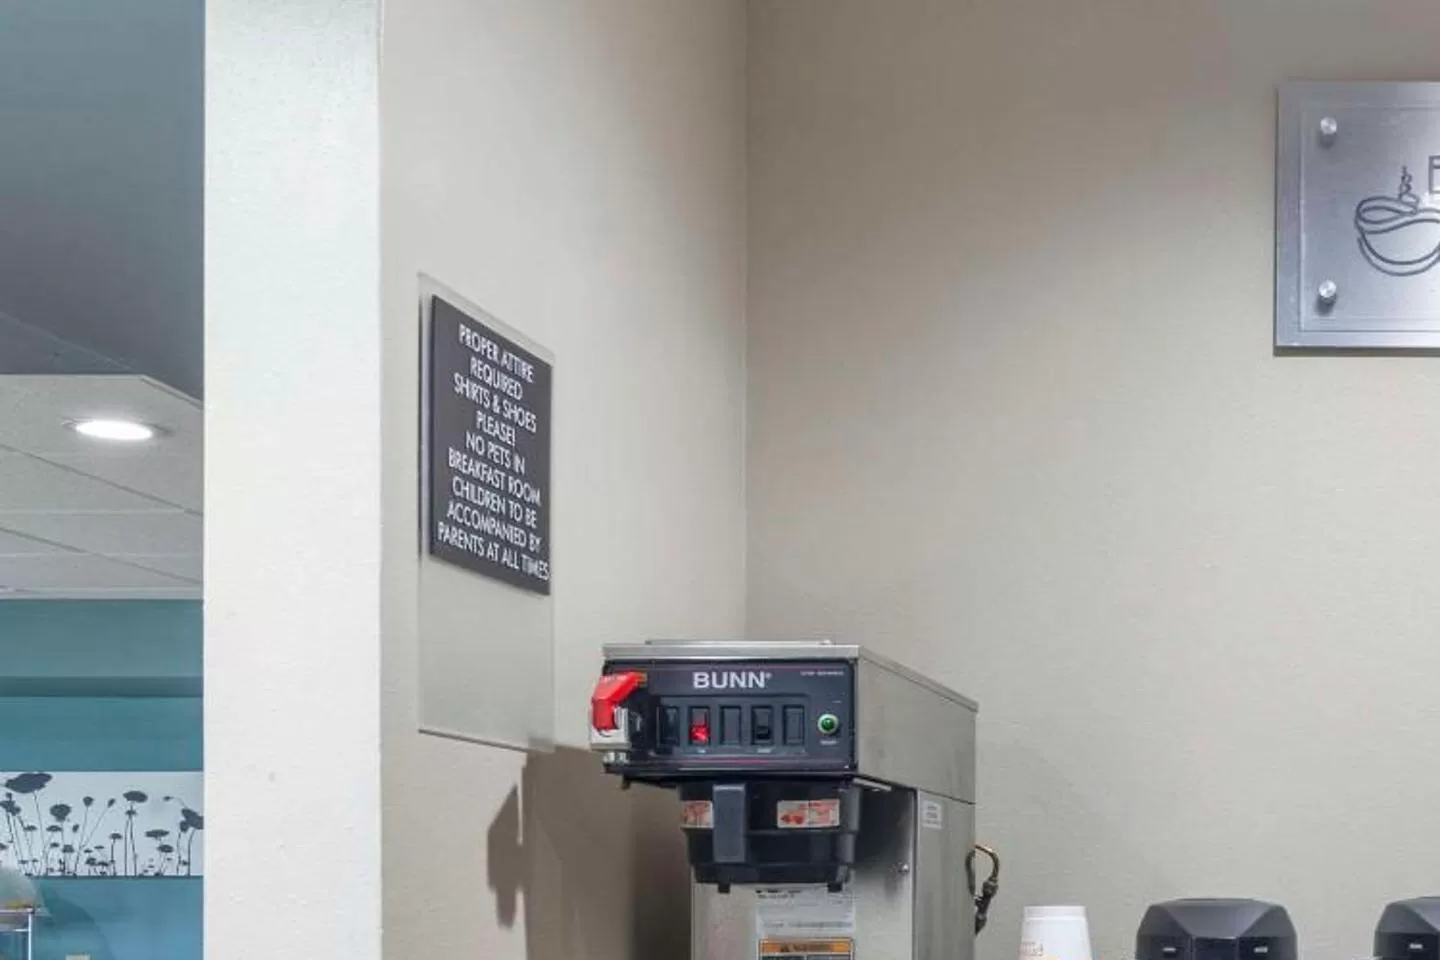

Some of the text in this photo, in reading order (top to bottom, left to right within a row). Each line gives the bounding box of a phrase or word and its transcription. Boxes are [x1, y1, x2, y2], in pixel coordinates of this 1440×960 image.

[459, 323, 534, 383] PROPER ATTIRE
[470, 356, 523, 400] REQUIRED
[453, 372, 537, 433] SHIRTS & SHOES
[448, 447, 506, 491] BREAKFAST
[465, 430, 525, 475] NO PETS IN
[446, 500, 542, 552] ACCOMPANIED BY
[452, 475, 537, 529] CHILDREN TO BE
[437, 521, 550, 580] PARENTS AT ALL TIMES
[692, 671, 766, 689] BUNN
